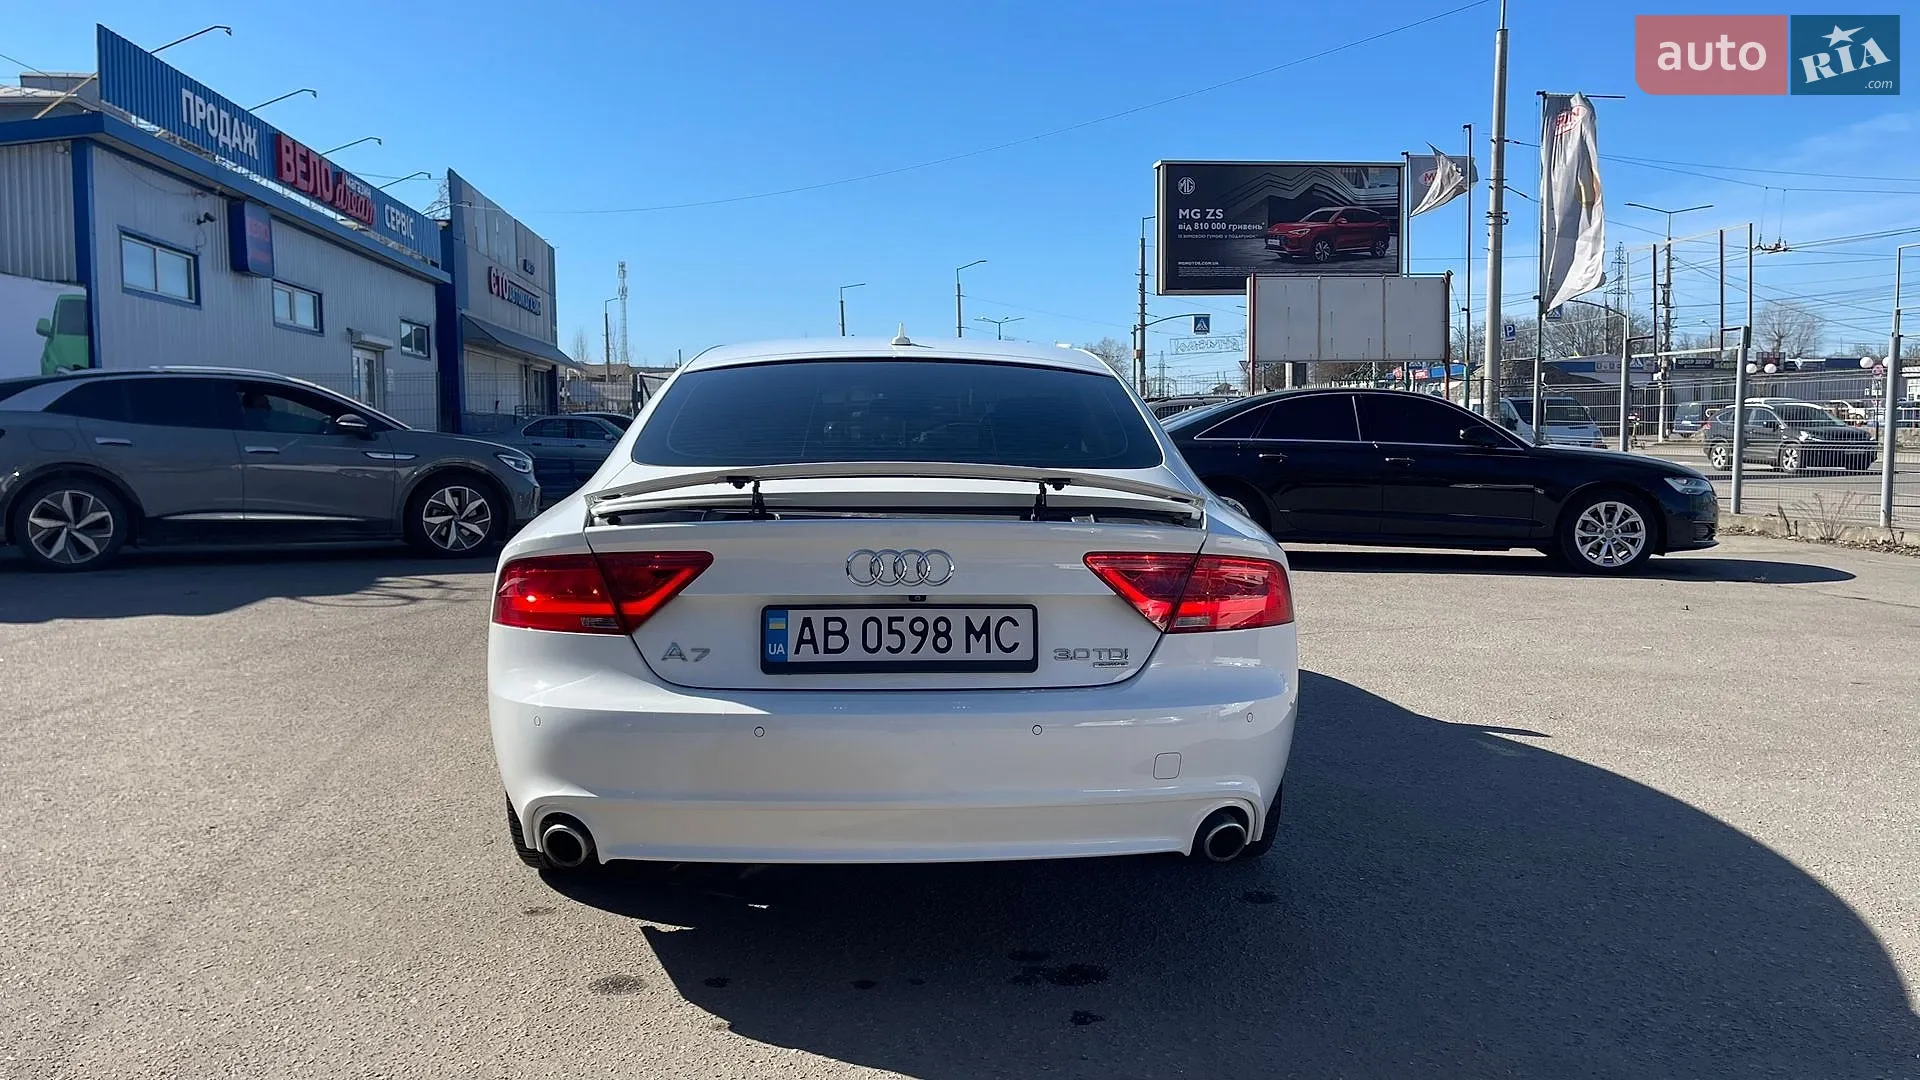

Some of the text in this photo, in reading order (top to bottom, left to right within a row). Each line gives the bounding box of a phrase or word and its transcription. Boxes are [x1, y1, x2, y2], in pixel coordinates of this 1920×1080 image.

[181, 88, 258, 160] ПРОДАЖ
[279, 133, 333, 202] ВЕЛО
[1178, 177, 1196, 195] MG
[384, 203, 415, 241] СЕРВІС
[1178, 208, 1224, 220] MG ZS
[1178, 222, 1192, 231] від
[1194, 222, 1209, 230] 810
[1211, 222, 1227, 230] 000
[1505, 325, 1514, 337] P
[793, 615, 1020, 655] AB 0598 MC
[768, 643, 786, 656] UA
